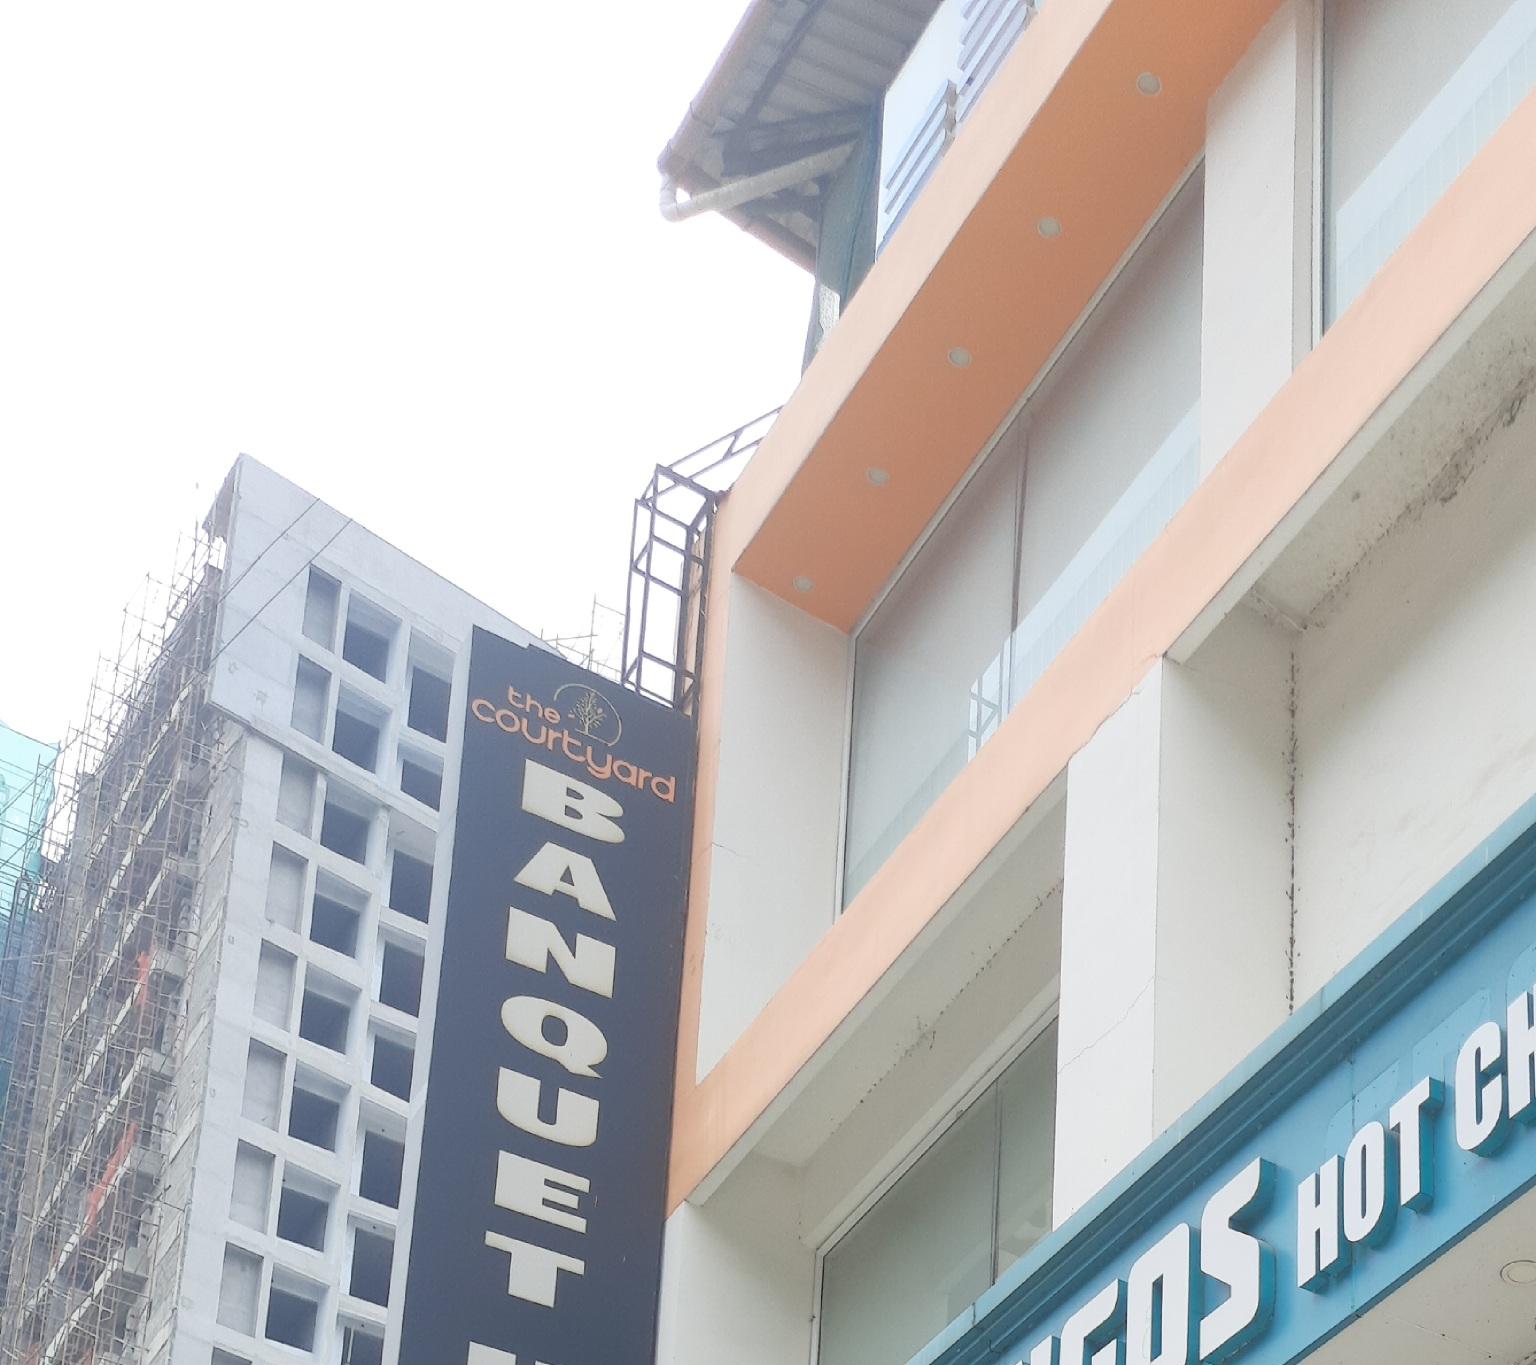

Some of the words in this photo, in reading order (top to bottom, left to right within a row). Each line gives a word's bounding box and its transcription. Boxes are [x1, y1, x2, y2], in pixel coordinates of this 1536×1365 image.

[471, 698, 677, 804] courtyard
[507, 685, 561, 724] the
[483, 758, 626, 1308] BANQUET
[1297, 1075, 1442, 1293] HOT
